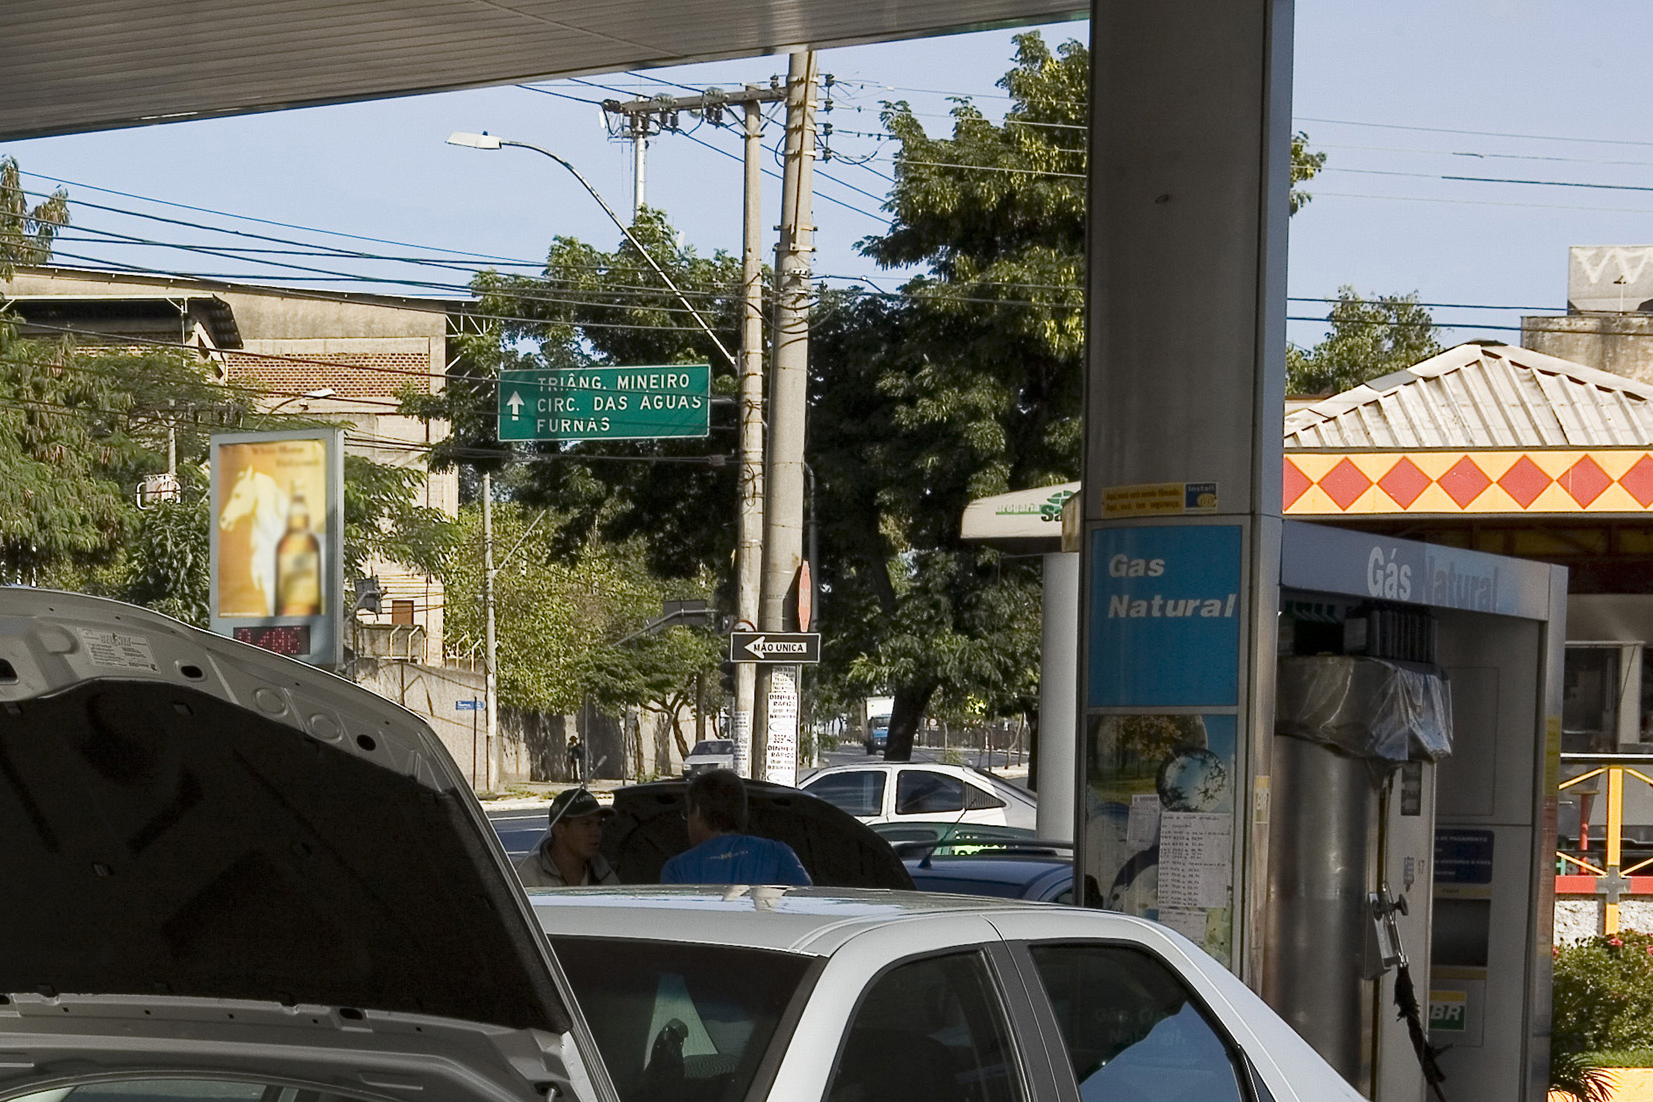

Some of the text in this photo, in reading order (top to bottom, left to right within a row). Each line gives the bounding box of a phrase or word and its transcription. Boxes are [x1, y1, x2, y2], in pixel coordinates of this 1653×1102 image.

[537, 373, 690, 392] TRIÂNG. MINEIRO
[537, 398, 580, 412] CIRC.
[594, 396, 628, 411] DAS
[537, 417, 610, 433] FURNAS
[1108, 553, 1165, 578] Gas
[1367, 546, 1499, 614] Gás Natural
[1107, 594, 1237, 619] Natural
[1429, 1005, 1462, 1021] BR
